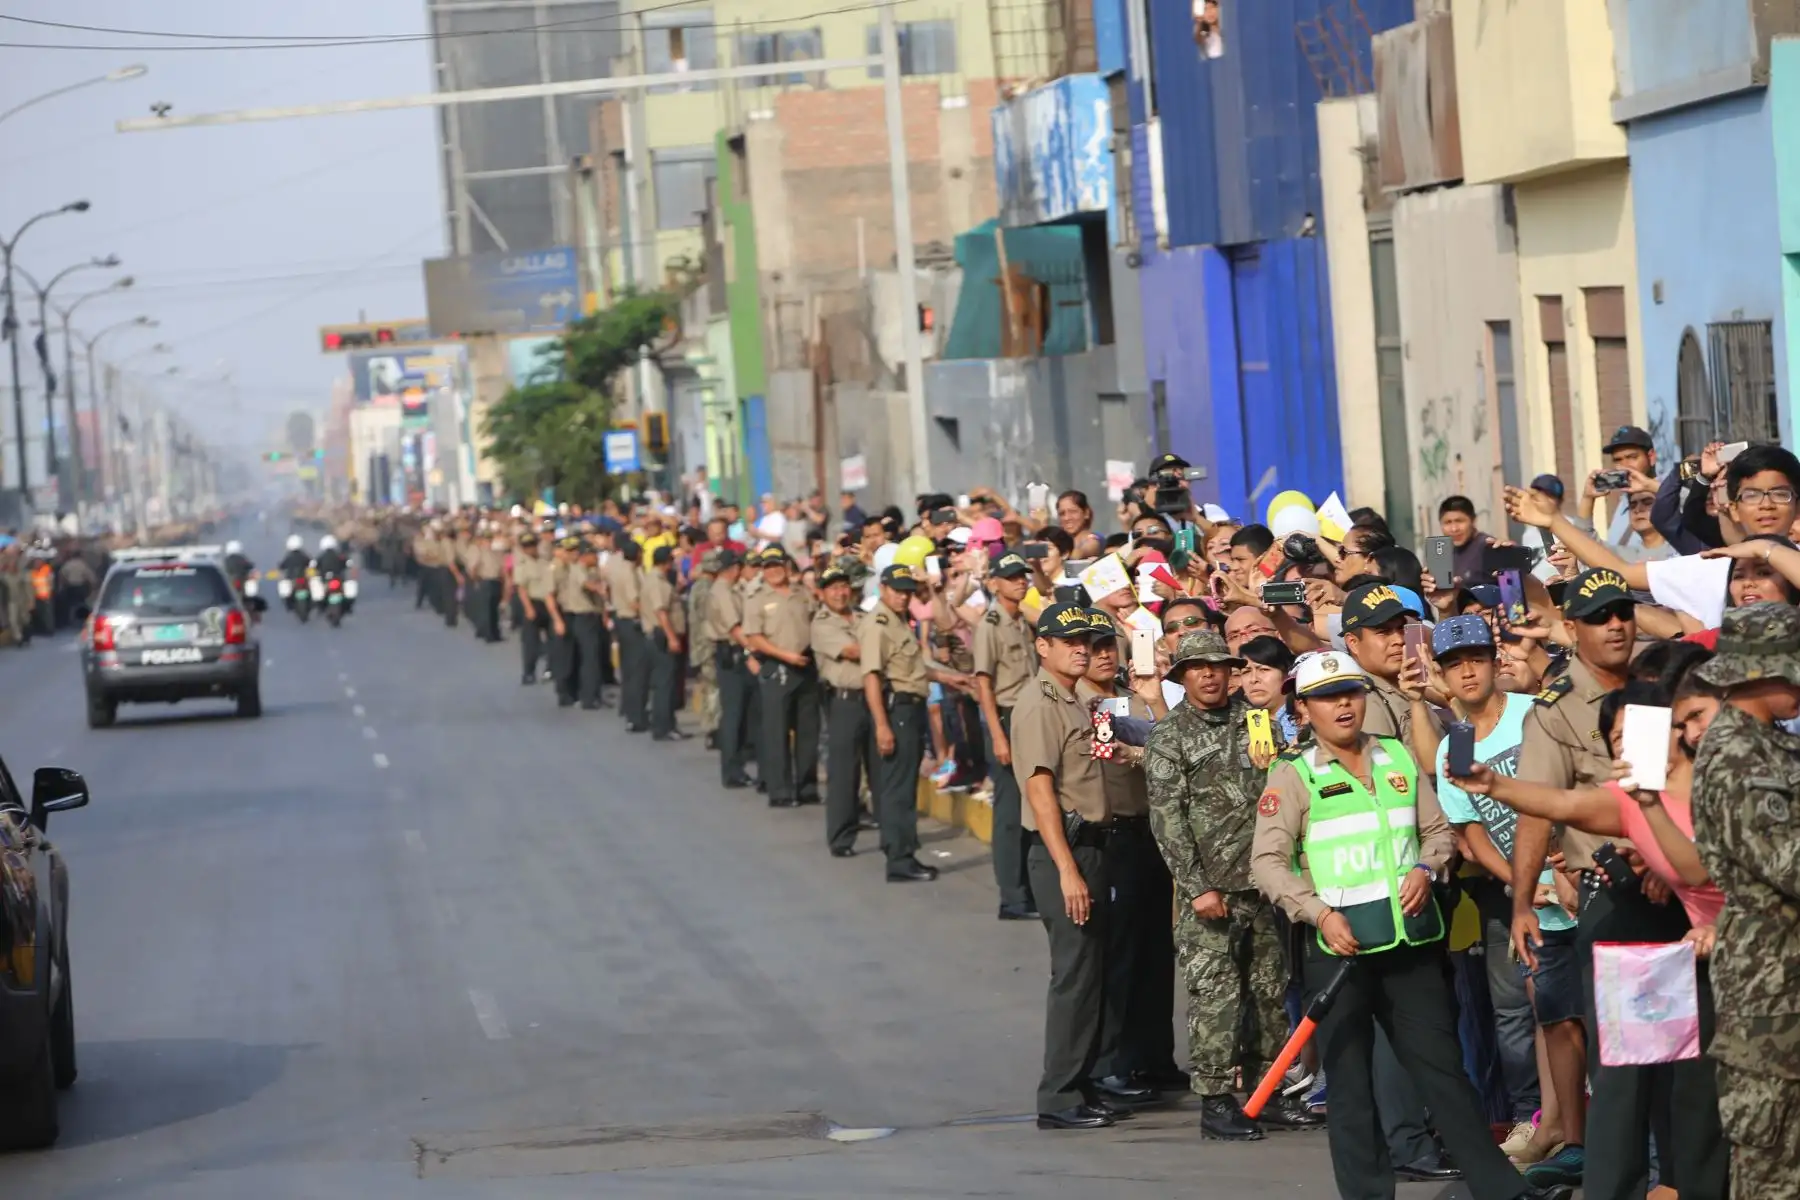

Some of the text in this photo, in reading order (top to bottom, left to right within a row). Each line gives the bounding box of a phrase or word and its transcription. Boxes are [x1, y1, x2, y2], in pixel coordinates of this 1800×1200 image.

[1579, 569, 1628, 599] POLICIA
[1361, 585, 1403, 611] POLIC
[1056, 606, 1090, 627] POLIC
[141, 647, 203, 665] POLICIA
